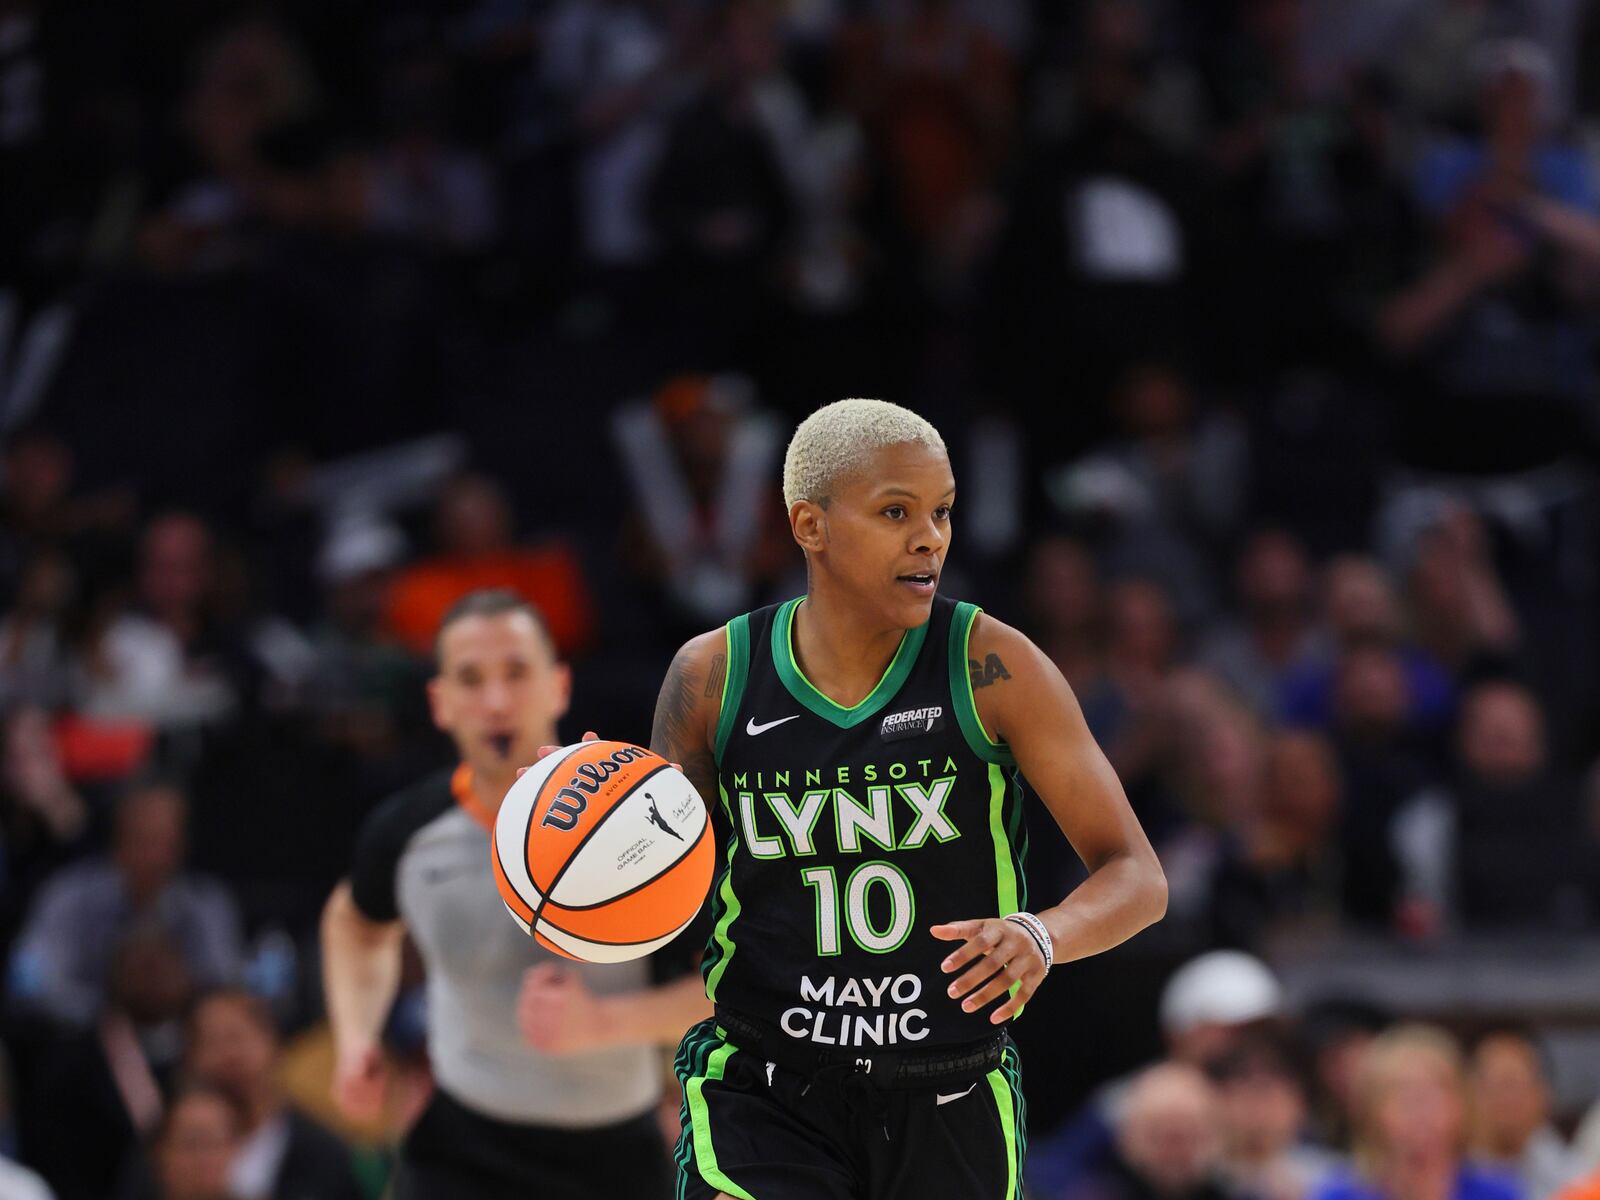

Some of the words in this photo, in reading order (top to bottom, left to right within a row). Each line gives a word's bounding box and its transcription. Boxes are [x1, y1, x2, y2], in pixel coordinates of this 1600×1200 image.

[880, 719, 923, 736] INSURANCE
[882, 706, 943, 727] FEDERATED
[541, 746, 654, 832] Wilson
[734, 756, 958, 790] MINNESOTA
[738, 775, 962, 860] LYNX
[617, 838, 647, 862] OFFICIAL
[617, 852, 637, 871] GAME
[637, 840, 656, 855] BALL
[800, 859, 916, 957] 10
[800, 973, 922, 1008] MAYO
[780, 1007, 931, 1047] CLINIC
